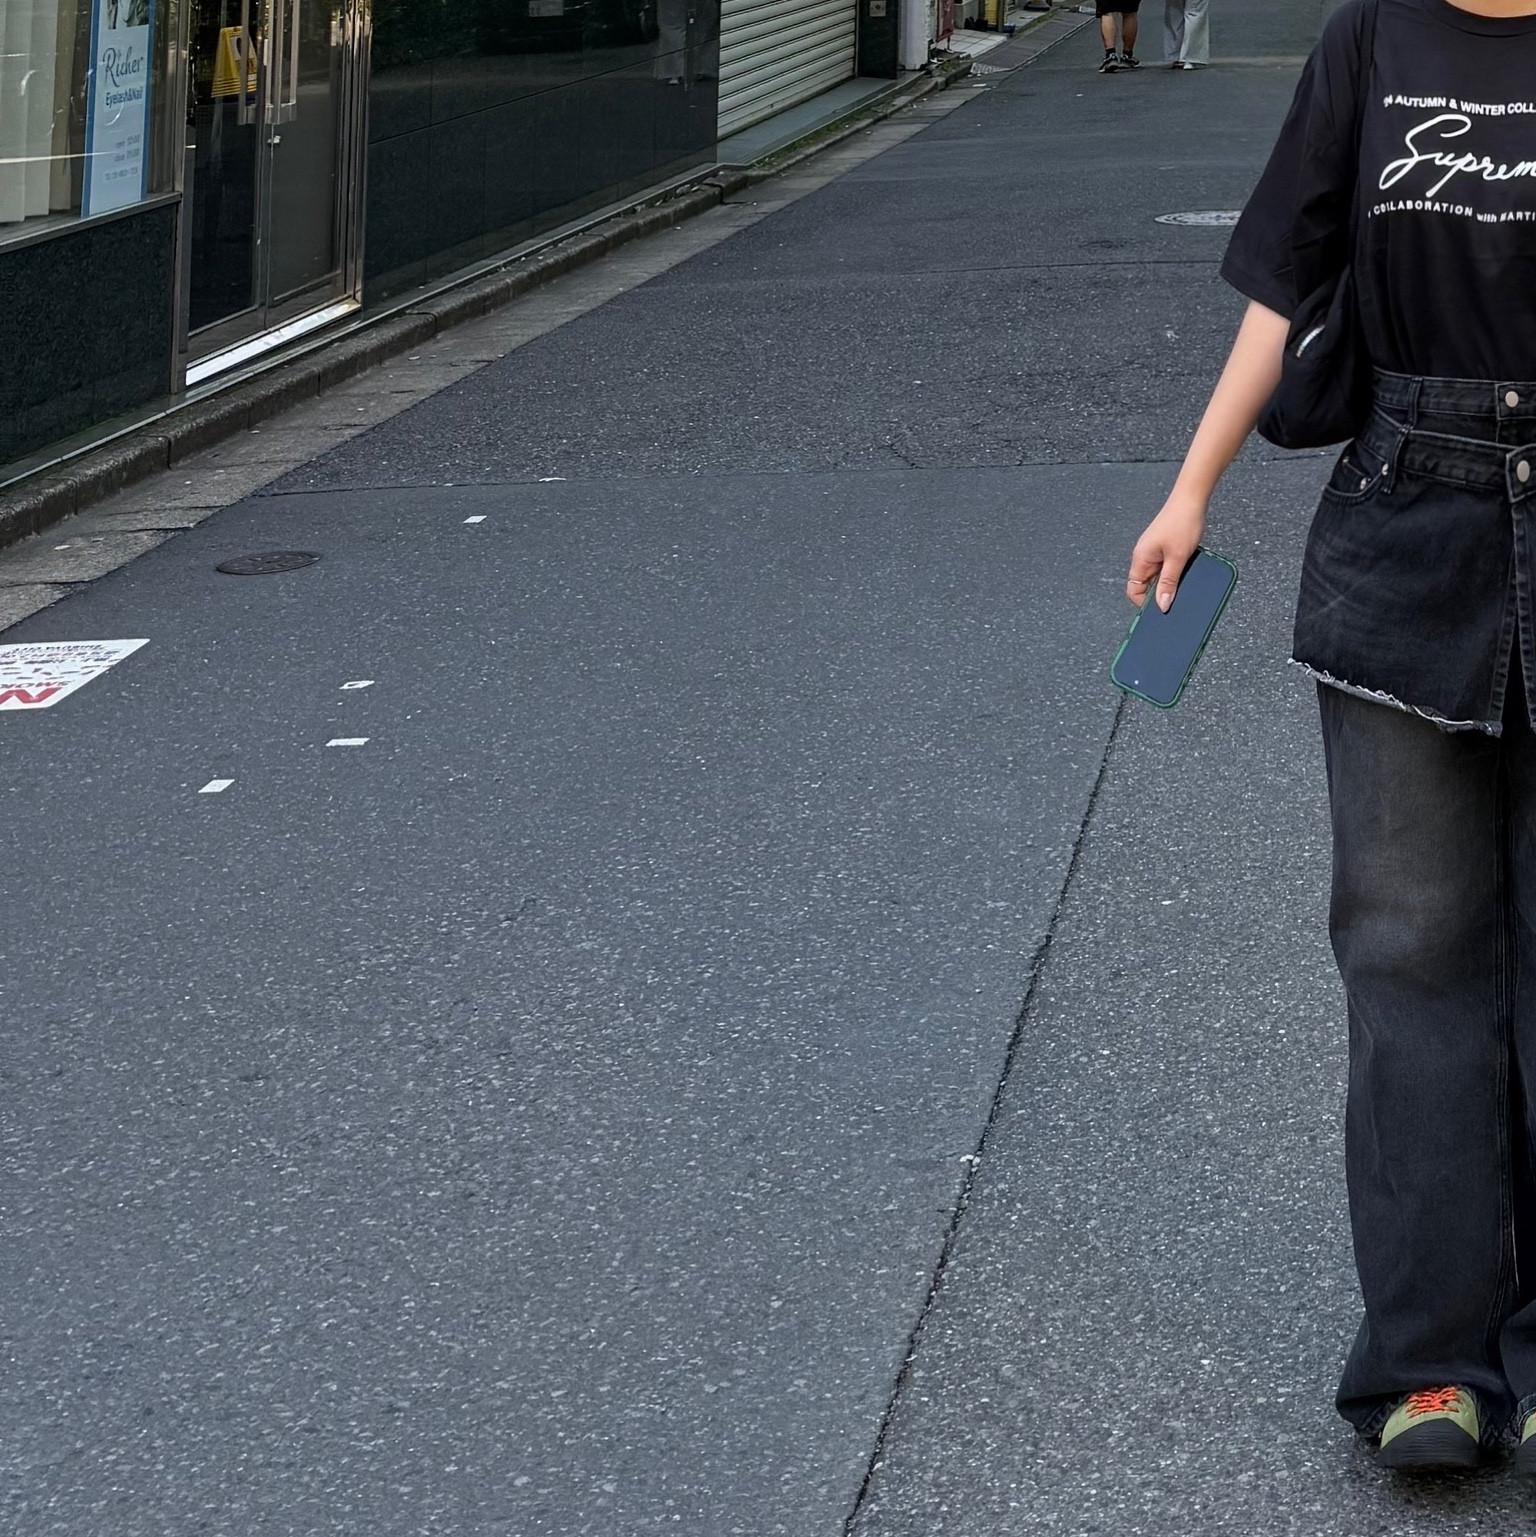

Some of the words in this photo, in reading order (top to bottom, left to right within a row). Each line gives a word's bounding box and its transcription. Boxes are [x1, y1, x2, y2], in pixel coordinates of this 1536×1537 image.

[102, 46, 145, 88] Richer
[1395, 94, 1447, 108] AUTUMN
[1449, 98, 1459, 110] &
[1460, 100, 1506, 116] WINTER
[1476, 212, 1498, 223] with
